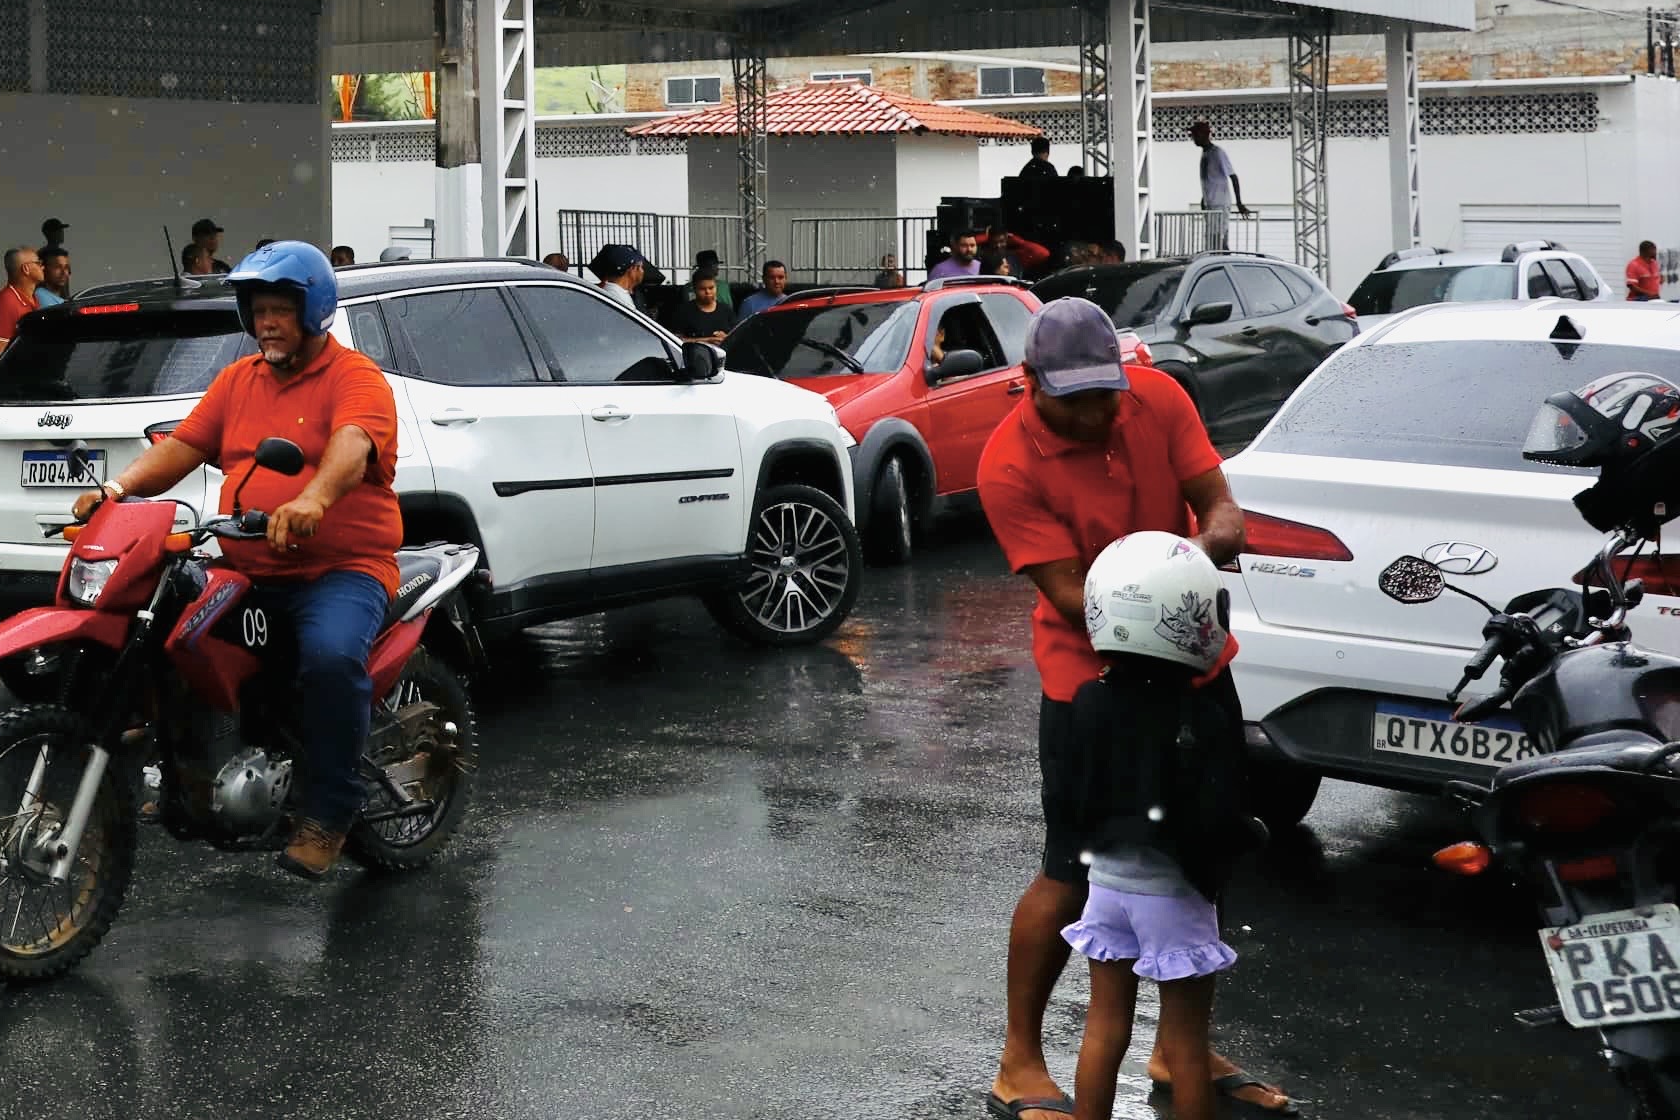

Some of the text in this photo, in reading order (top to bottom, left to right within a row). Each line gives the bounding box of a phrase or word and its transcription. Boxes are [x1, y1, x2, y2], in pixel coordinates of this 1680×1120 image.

[397, 572, 432, 598] HONDA
[1250, 561, 1317, 578] HB20S
[243, 608, 267, 647] 09
[1564, 933, 1678, 980] PKA
